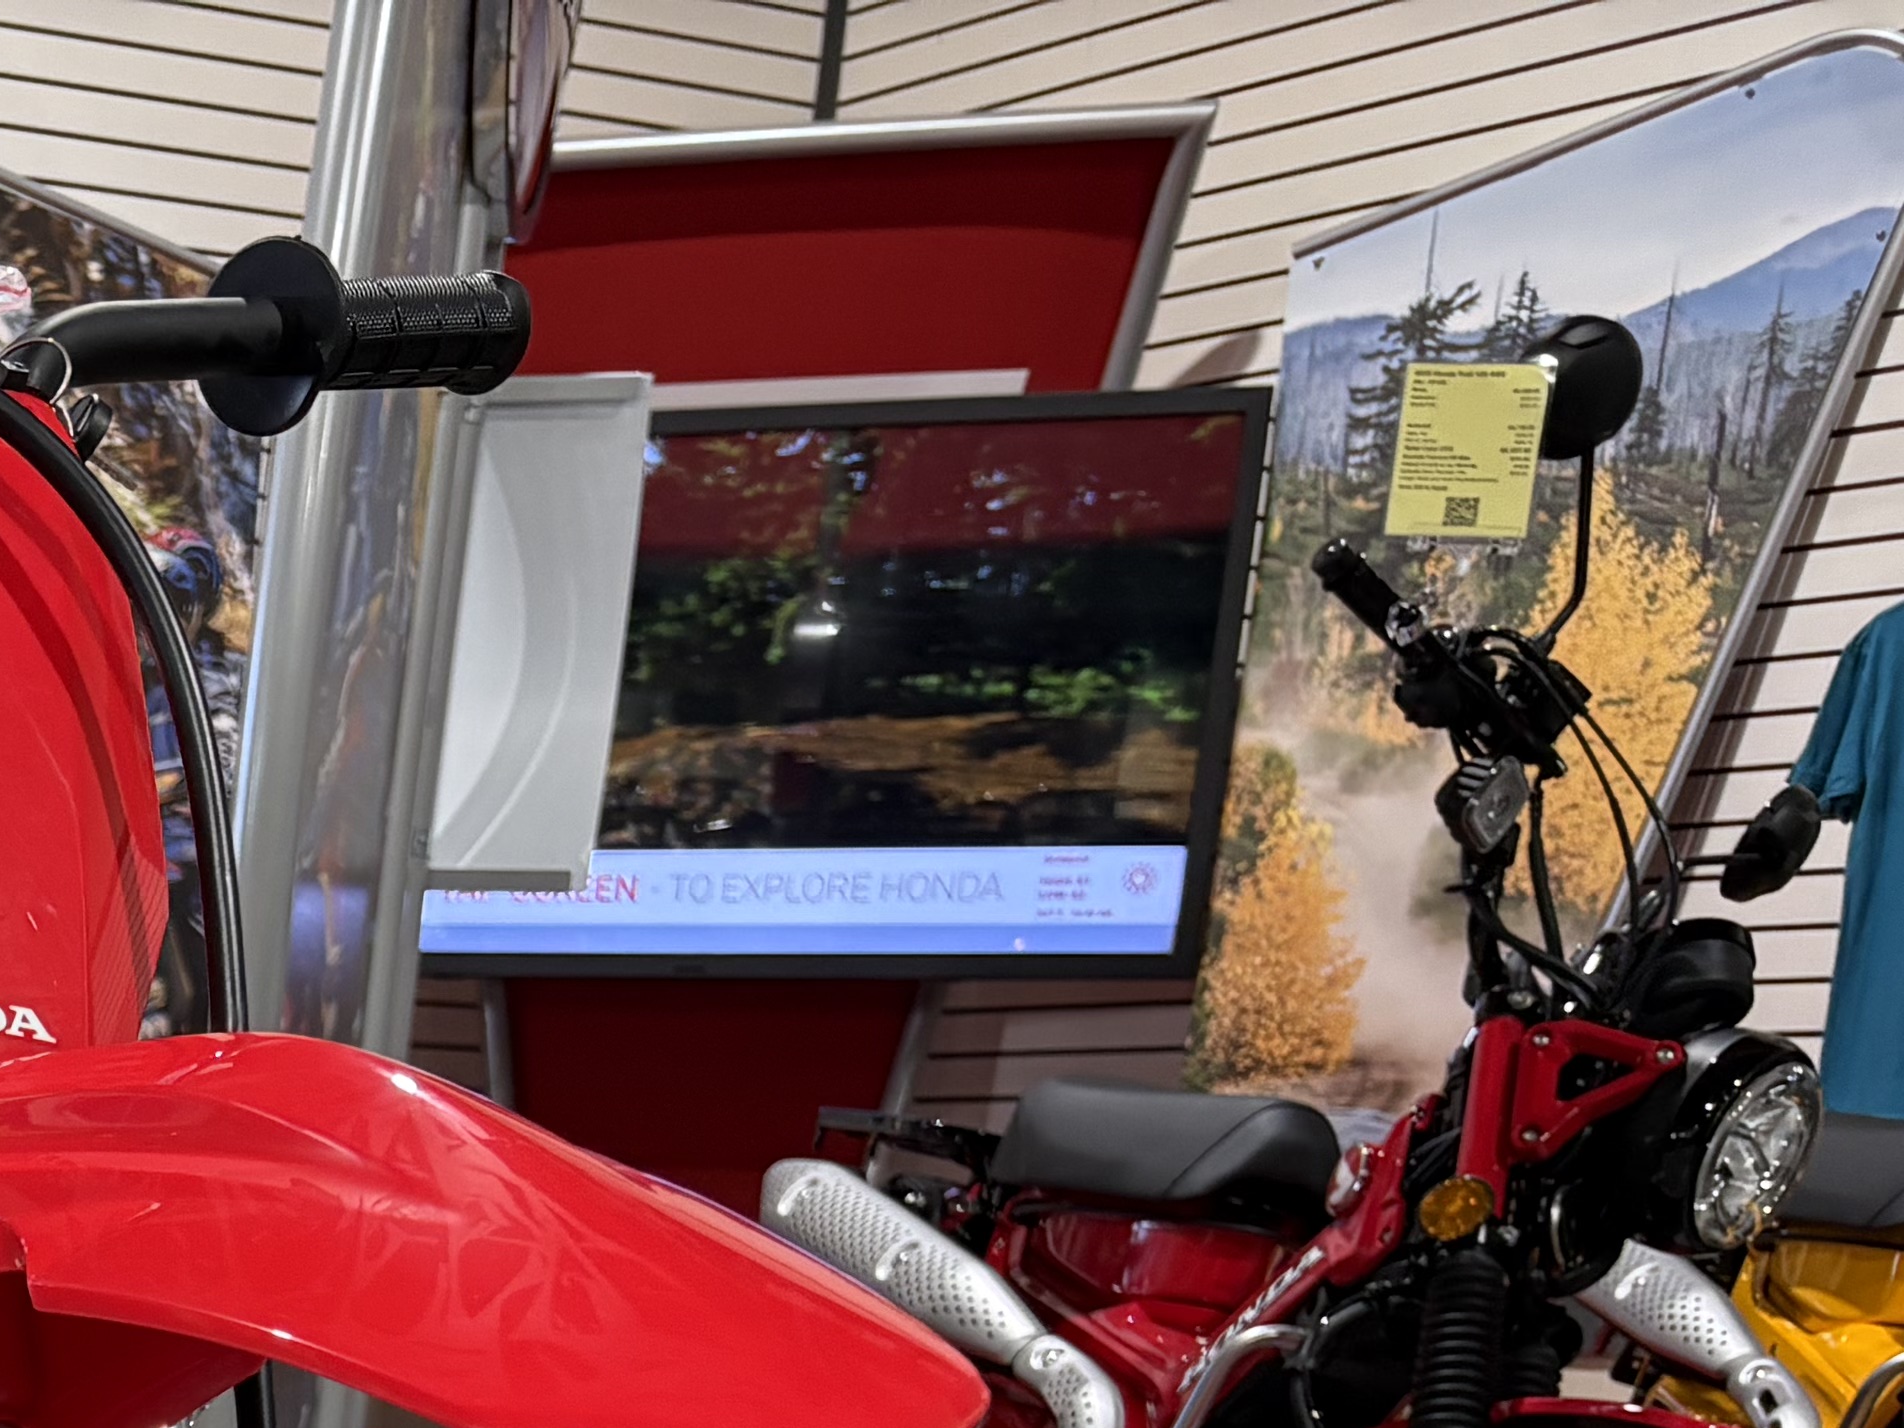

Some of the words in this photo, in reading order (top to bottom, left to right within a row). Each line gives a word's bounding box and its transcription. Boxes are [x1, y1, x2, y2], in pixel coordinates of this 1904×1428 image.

[670, 873, 709, 901] TO
[720, 871, 872, 904] EXPLORE
[880, 871, 1005, 902] HONDA
